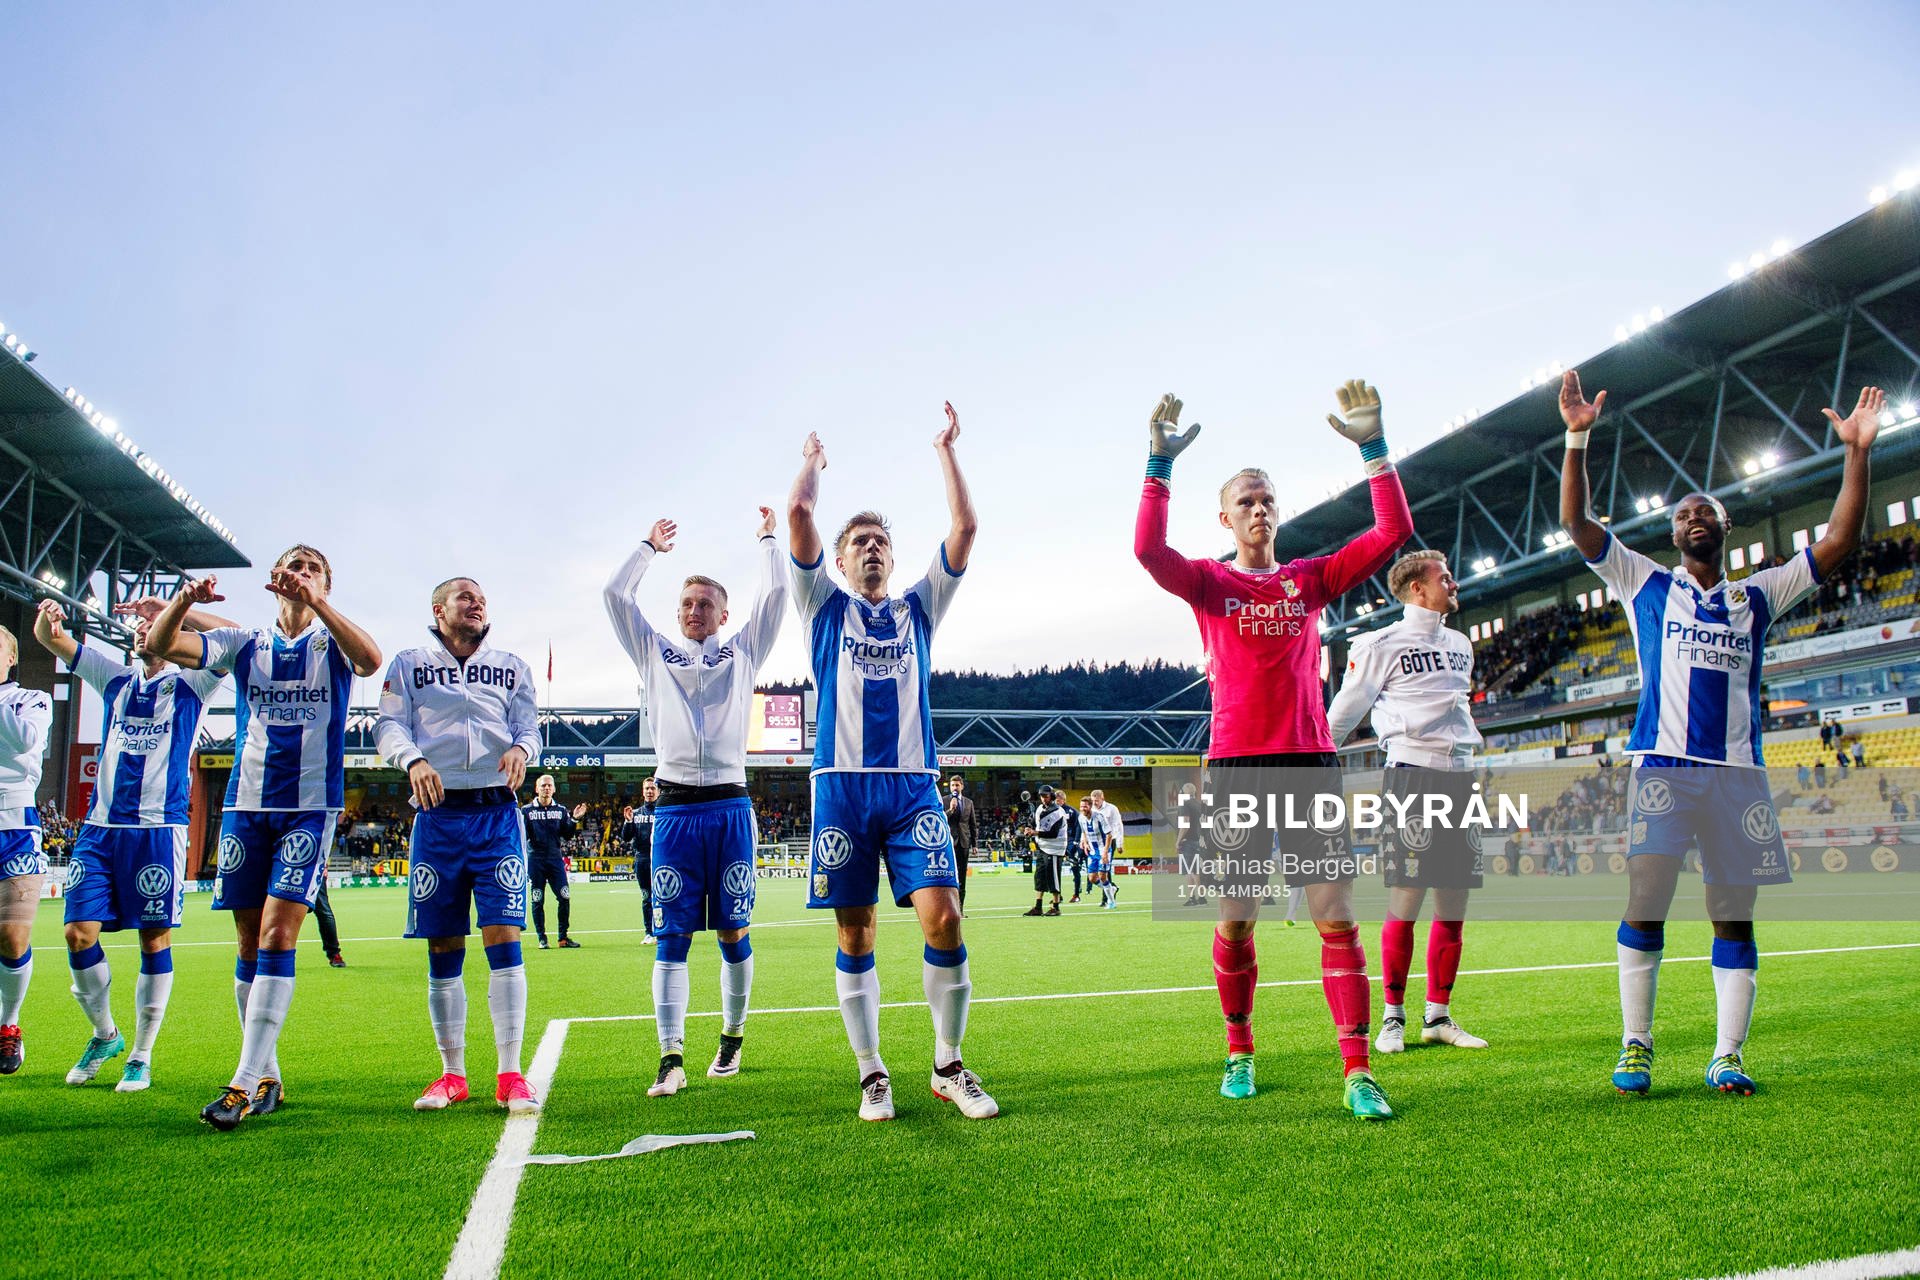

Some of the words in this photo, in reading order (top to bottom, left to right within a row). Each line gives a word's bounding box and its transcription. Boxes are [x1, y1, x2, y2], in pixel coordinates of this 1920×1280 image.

[1224, 597, 1308, 618] Prioritet
[1238, 616, 1301, 637] Finans
[1666, 621, 1751, 653] Prioritet
[842, 636, 915, 660] Prioritet
[1677, 641, 1741, 670] Finans
[851, 653, 908, 677] Finans
[1400, 649, 1445, 675] GÖTE
[413, 662, 460, 690] GÖTE
[466, 664, 516, 690] BORG
[249, 685, 328, 703] Prioritet
[257, 703, 317, 721] Finans
[543, 754, 569, 767] ellos
[575, 754, 601, 767] ellos
[528, 810, 546, 820] GÖTE
[1323, 837, 1346, 857] 12
[927, 852, 949, 869] 16
[1762, 850, 1778, 867] 22
[281, 866, 305, 886] 28
[1752, 867, 1785, 876] Kappa
[143, 899, 166, 914] 42
[507, 893, 524, 910] 32
[733, 898, 748, 914] 24
